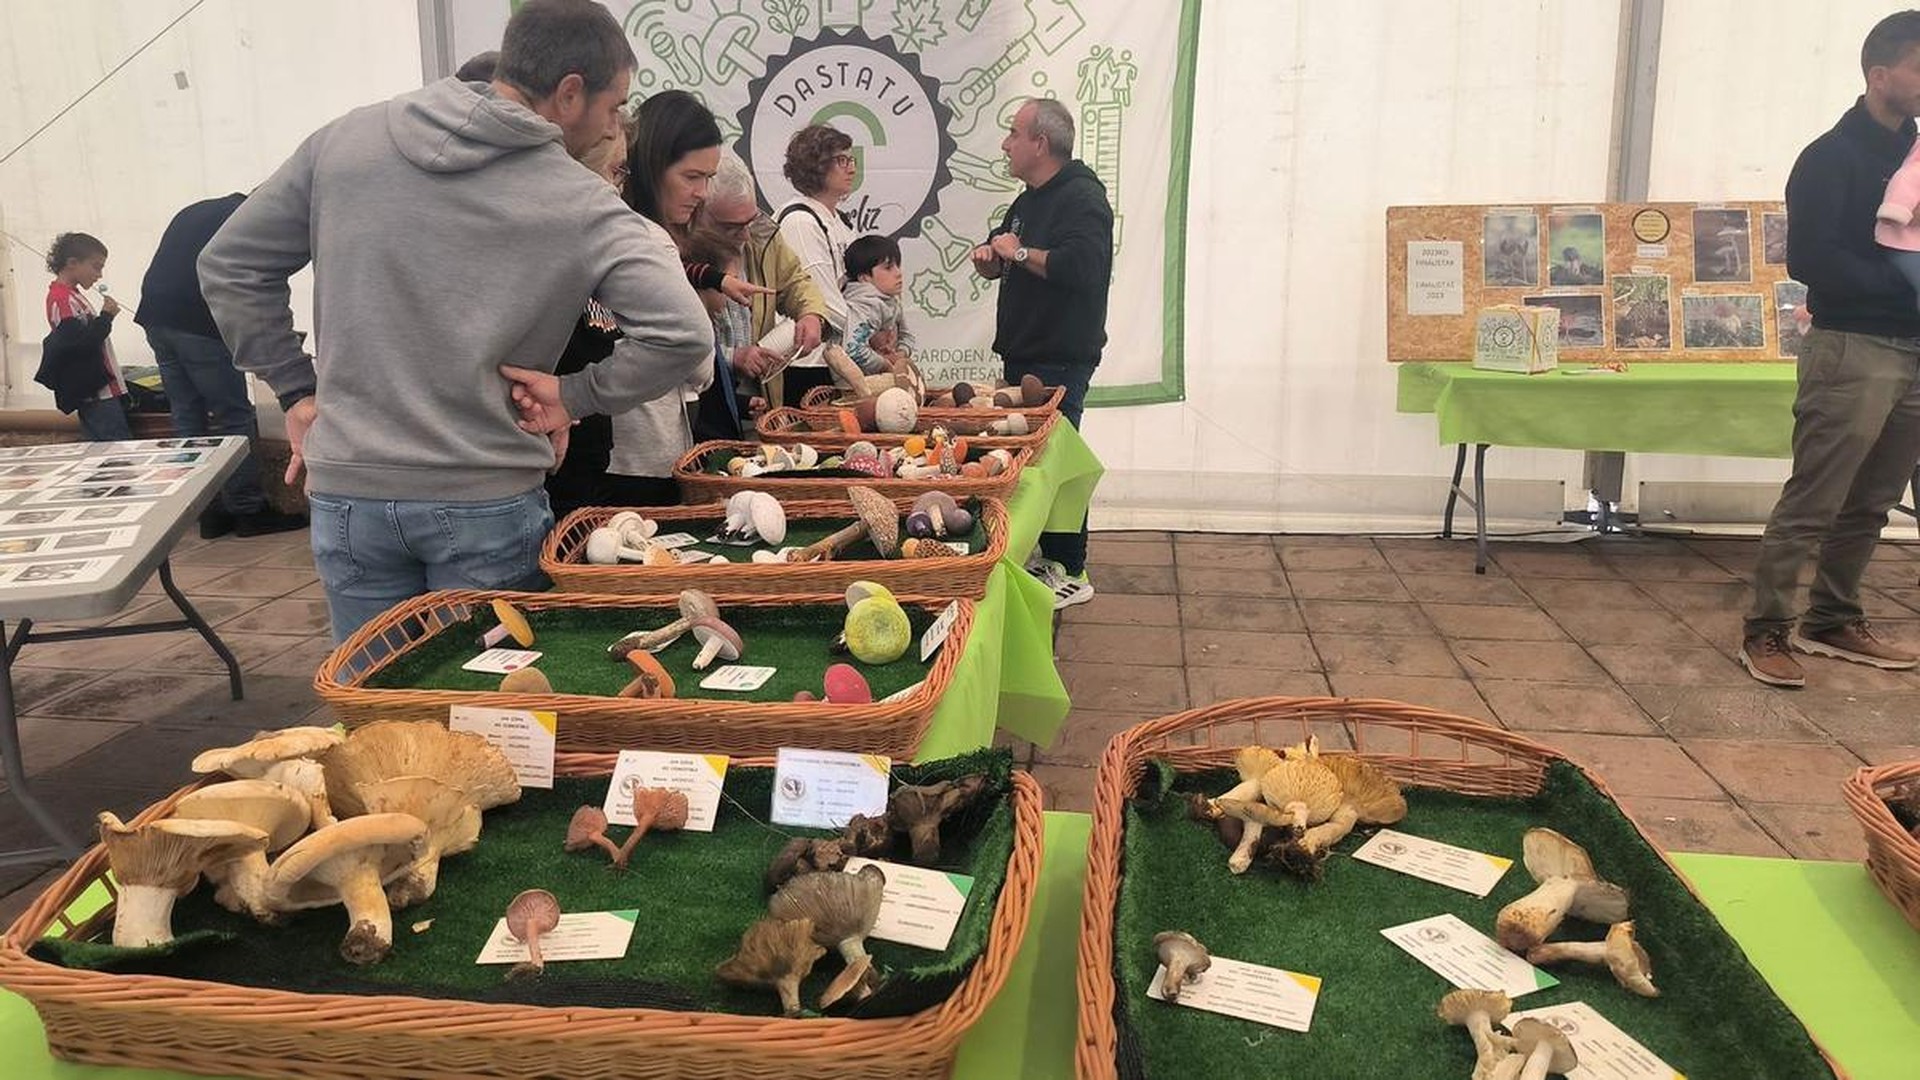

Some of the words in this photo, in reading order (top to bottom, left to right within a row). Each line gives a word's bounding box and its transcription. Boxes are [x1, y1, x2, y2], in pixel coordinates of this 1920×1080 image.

[774, 62, 914, 117] DASTATU
[912, 348, 984, 363] GARDOEN
[939, 367, 1003, 381] ARTESA
